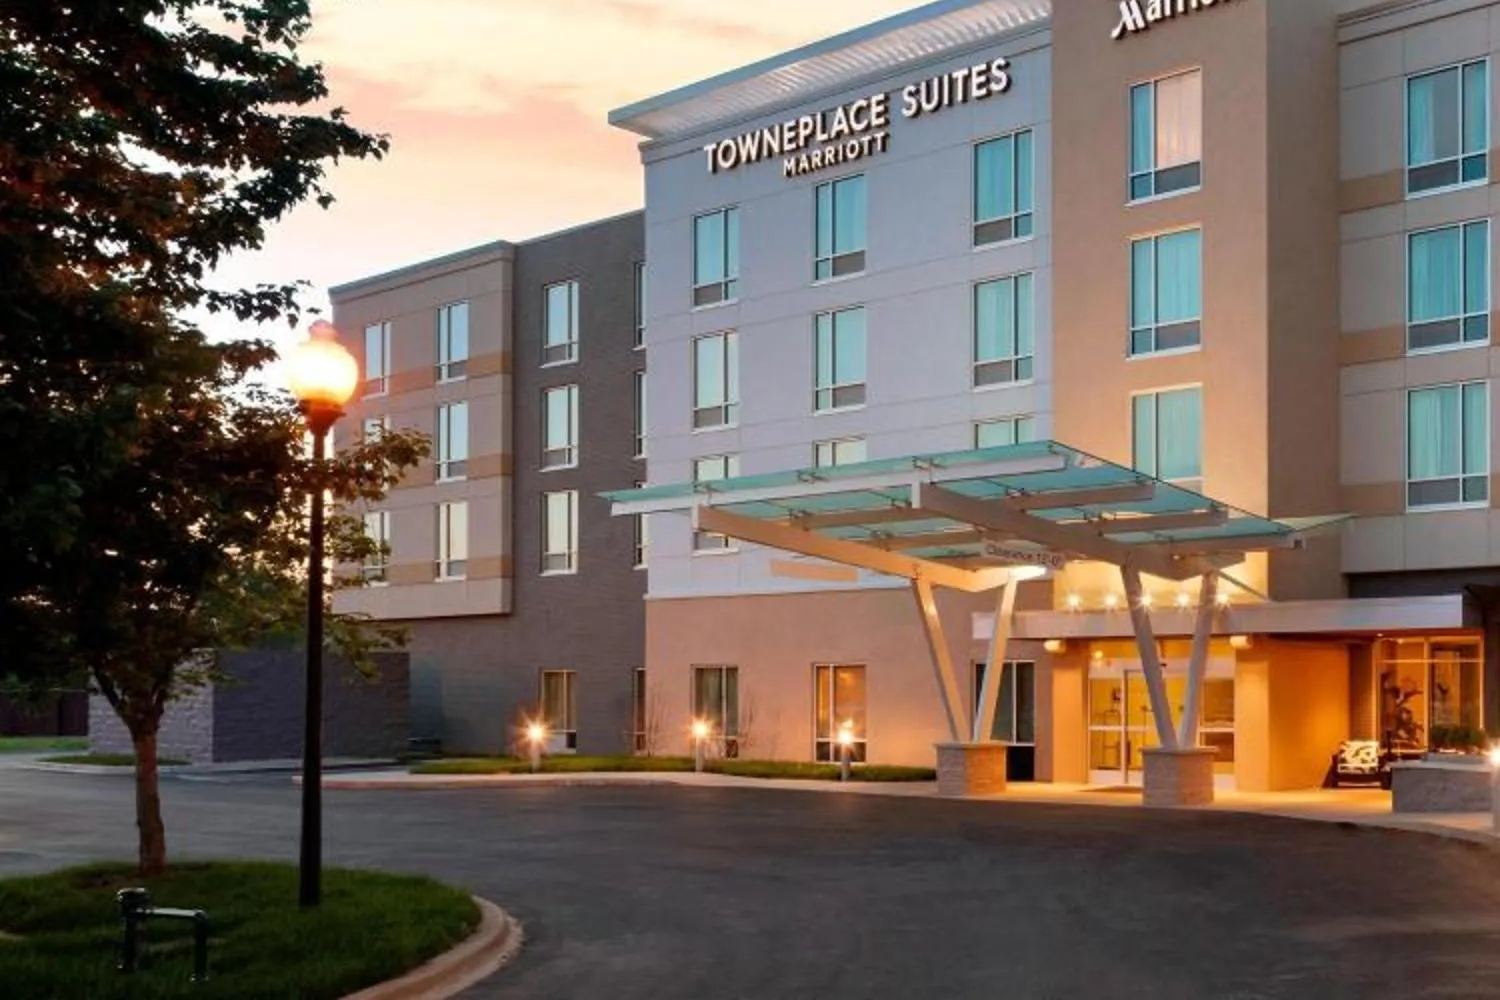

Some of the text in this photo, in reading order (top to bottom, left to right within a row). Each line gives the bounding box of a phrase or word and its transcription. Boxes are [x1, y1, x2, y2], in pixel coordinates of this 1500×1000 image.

[703, 58, 1010, 174] TOWNEPLACE SUITES
[783, 132, 888, 177] MARRIOTT
